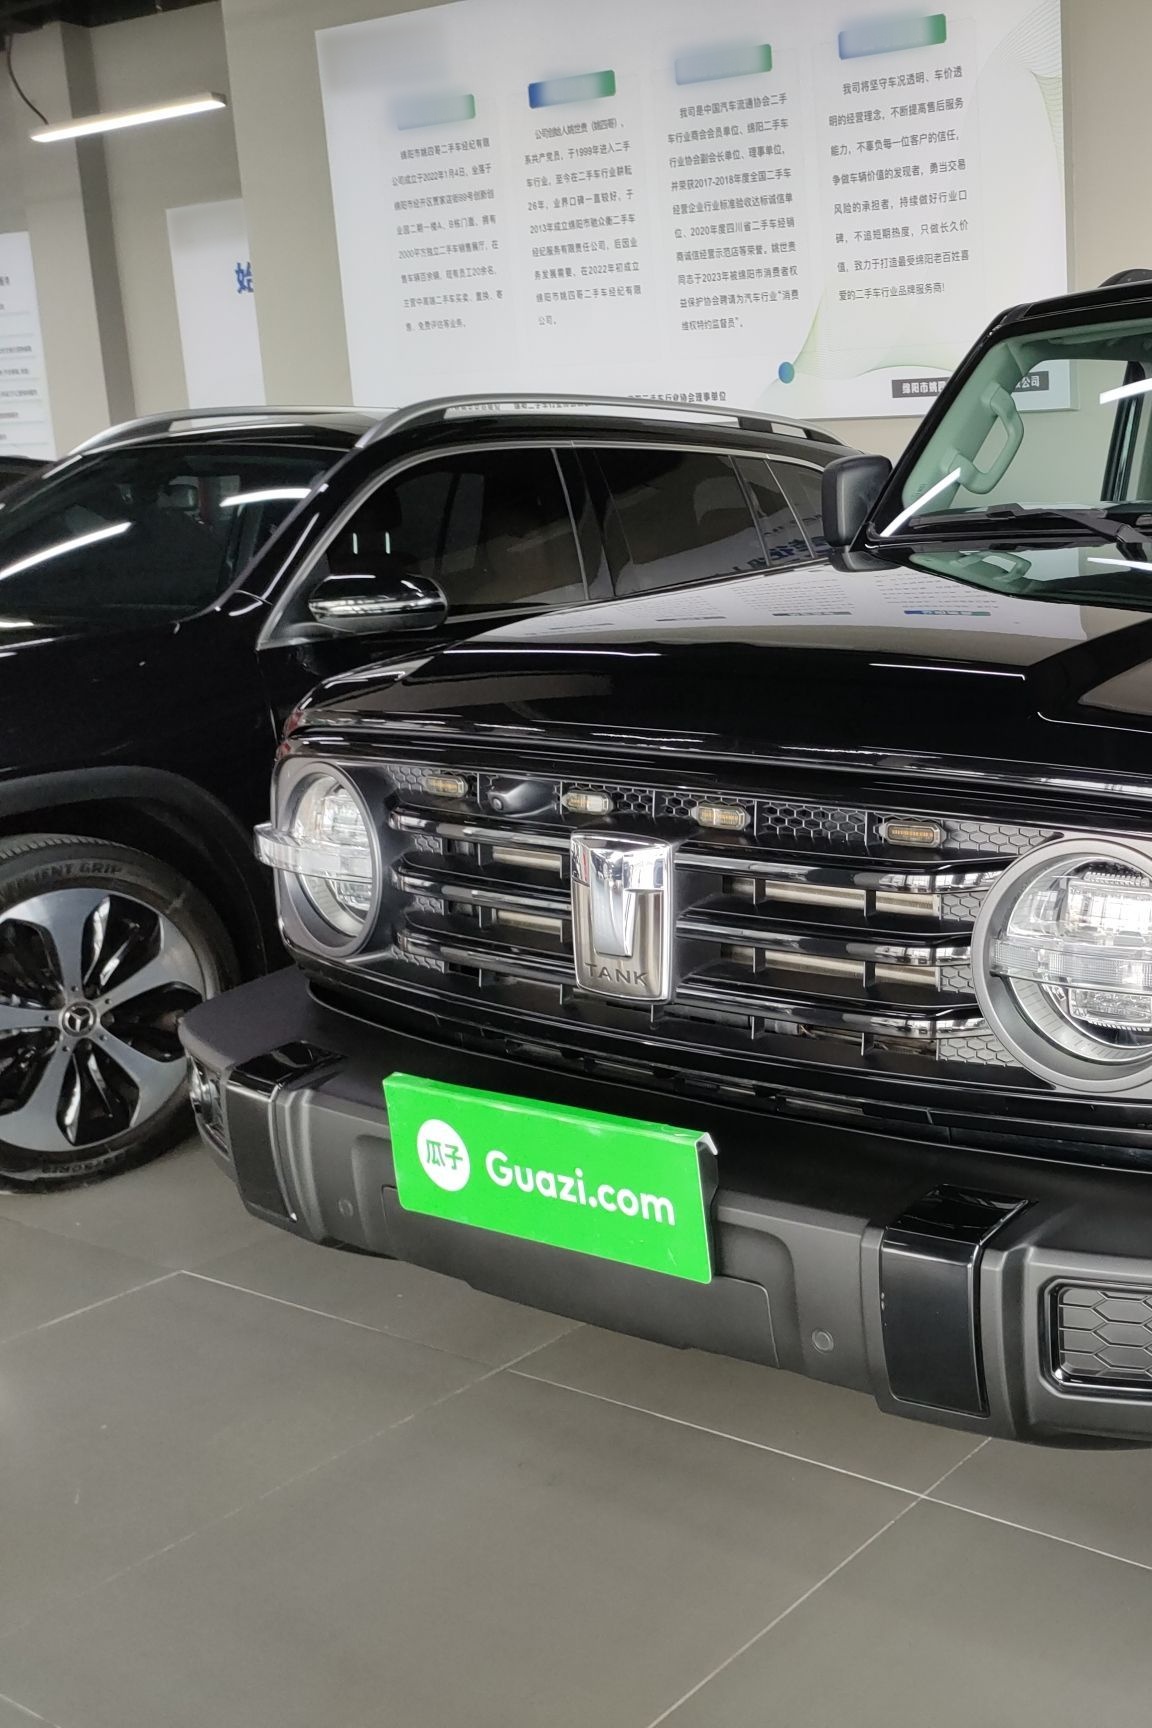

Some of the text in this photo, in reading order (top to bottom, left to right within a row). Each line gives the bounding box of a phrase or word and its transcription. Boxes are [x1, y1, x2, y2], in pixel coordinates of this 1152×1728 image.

[834, 190, 967, 215] 风险的承担者，持续做好行业口
[584, 963, 649, 987] TANK
[426, 1140, 463, 1170] 瓜子
[485, 1150, 676, 1227] Guazi.com
